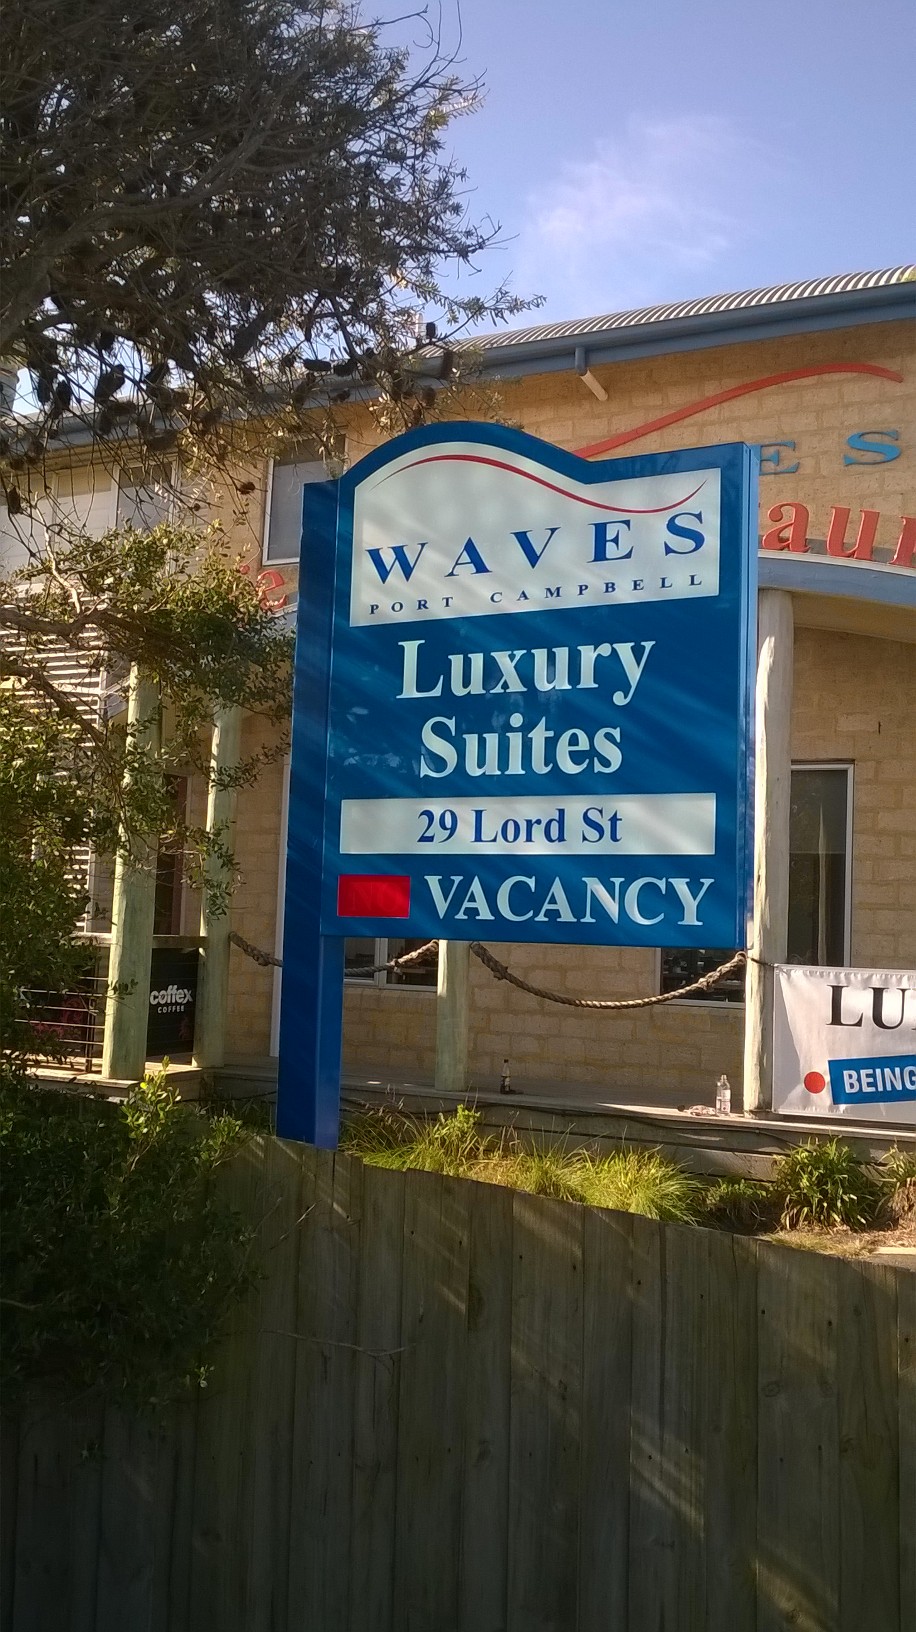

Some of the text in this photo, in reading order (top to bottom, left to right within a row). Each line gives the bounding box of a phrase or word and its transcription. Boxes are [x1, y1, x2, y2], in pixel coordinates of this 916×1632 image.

[365, 511, 706, 584] WAVES
[370, 574, 702, 615] PORT CAMPBELL
[396, 639, 656, 706] Luxury
[419, 712, 623, 778] Suites
[416, 807, 623, 843] 29 Lord St
[424, 875, 715, 925] VACANCY
[150, 985, 193, 1004] coffex
[157, 1005, 185, 1014] COFFEE
[826, 984, 916, 1030] LU
[843, 1066, 916, 1093] BEING
